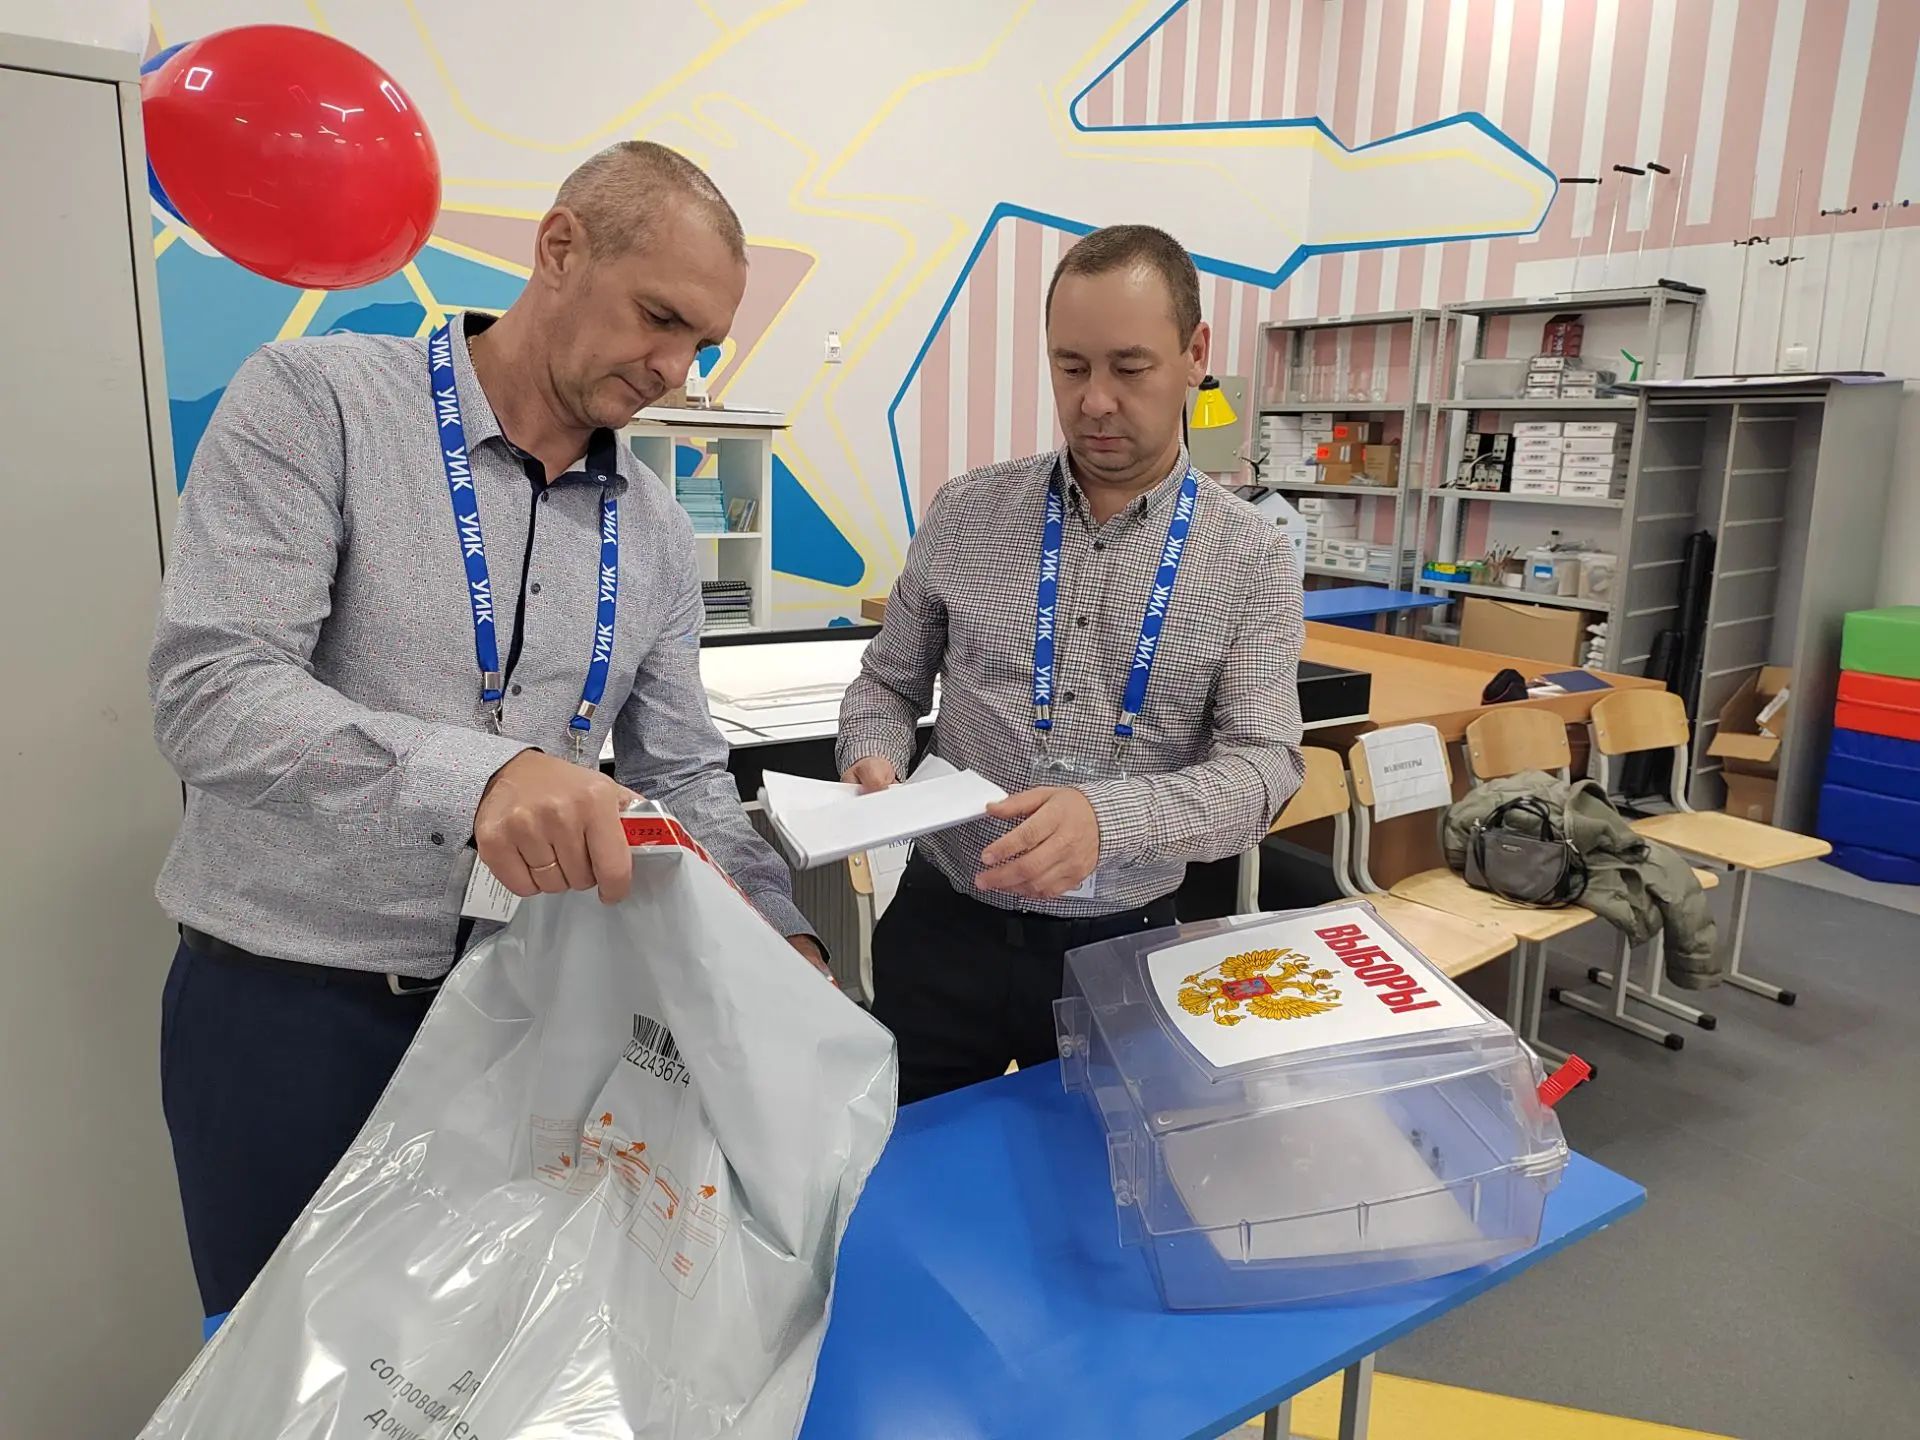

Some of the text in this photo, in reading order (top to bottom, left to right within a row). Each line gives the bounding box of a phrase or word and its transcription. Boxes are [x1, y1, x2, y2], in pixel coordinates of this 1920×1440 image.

[431, 333, 494, 626] УИК УИК УИК УИК УИК
[593, 506, 616, 664] УИК УИК УИК
[1035, 492, 1062, 701] УИК УИК УИК УИК
[1134, 633, 1156, 671] УИК
[1147, 583, 1171, 618] УИК
[1161, 535, 1184, 569] УИК
[1175, 491, 1195, 523] УИК
[1312, 924, 1442, 1014] ВЫБОРЫ
